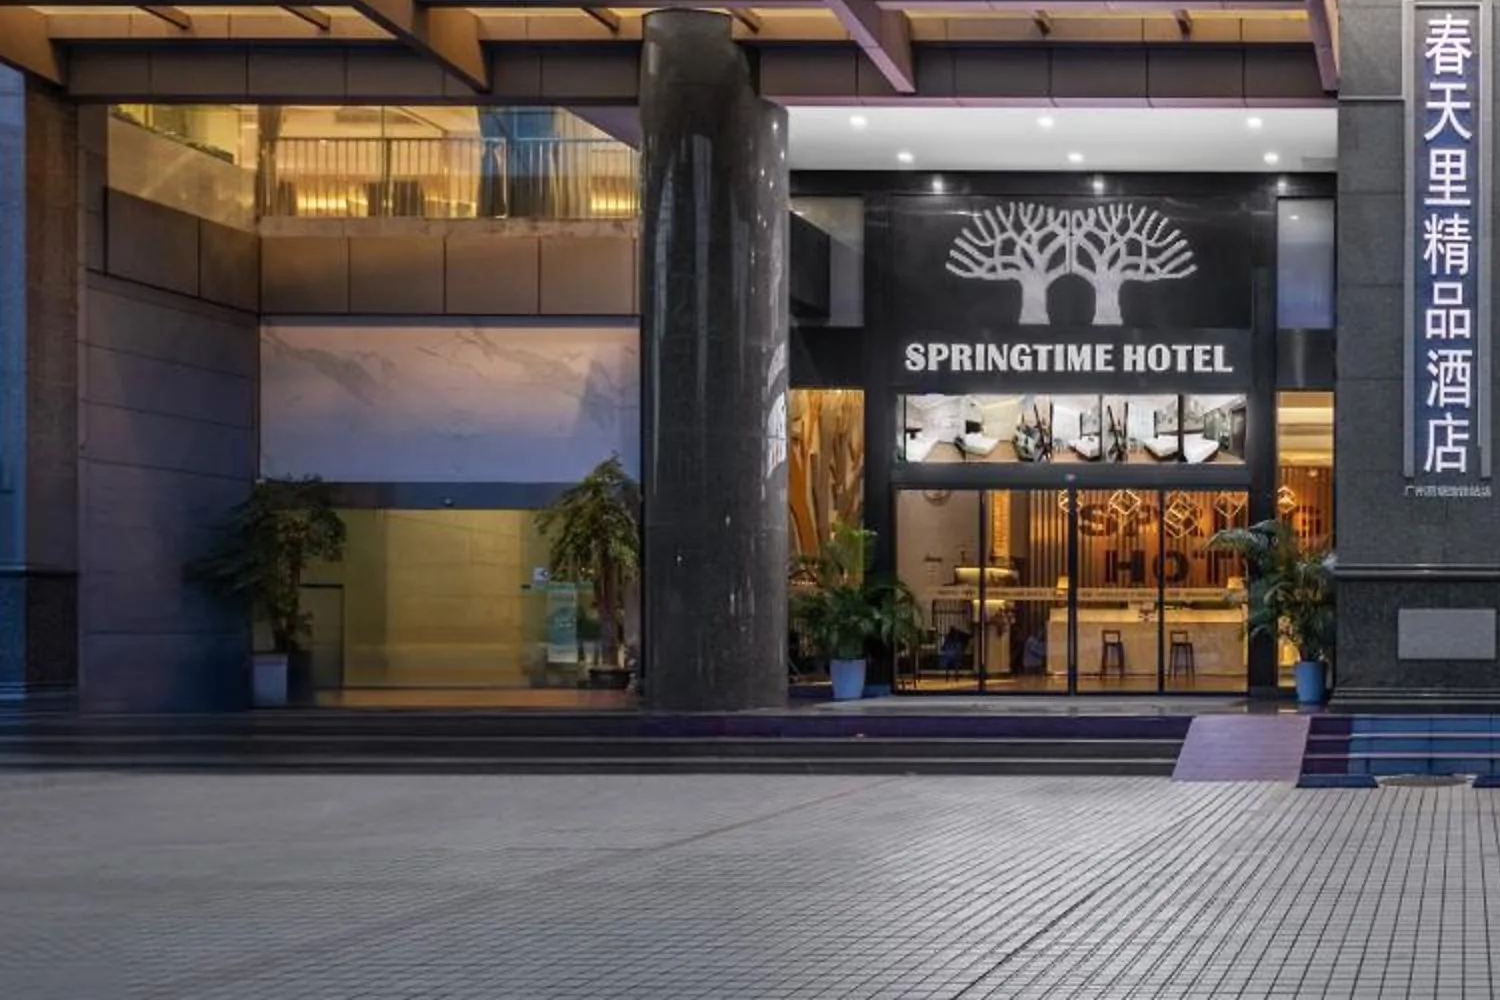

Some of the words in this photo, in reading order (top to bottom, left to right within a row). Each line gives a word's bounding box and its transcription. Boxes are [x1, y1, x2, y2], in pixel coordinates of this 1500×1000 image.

[904, 343, 1115, 373] SPRINGTIME
[1123, 343, 1234, 373] HOTEL
[1422, 12, 1474, 474] 春天里精品酒店
